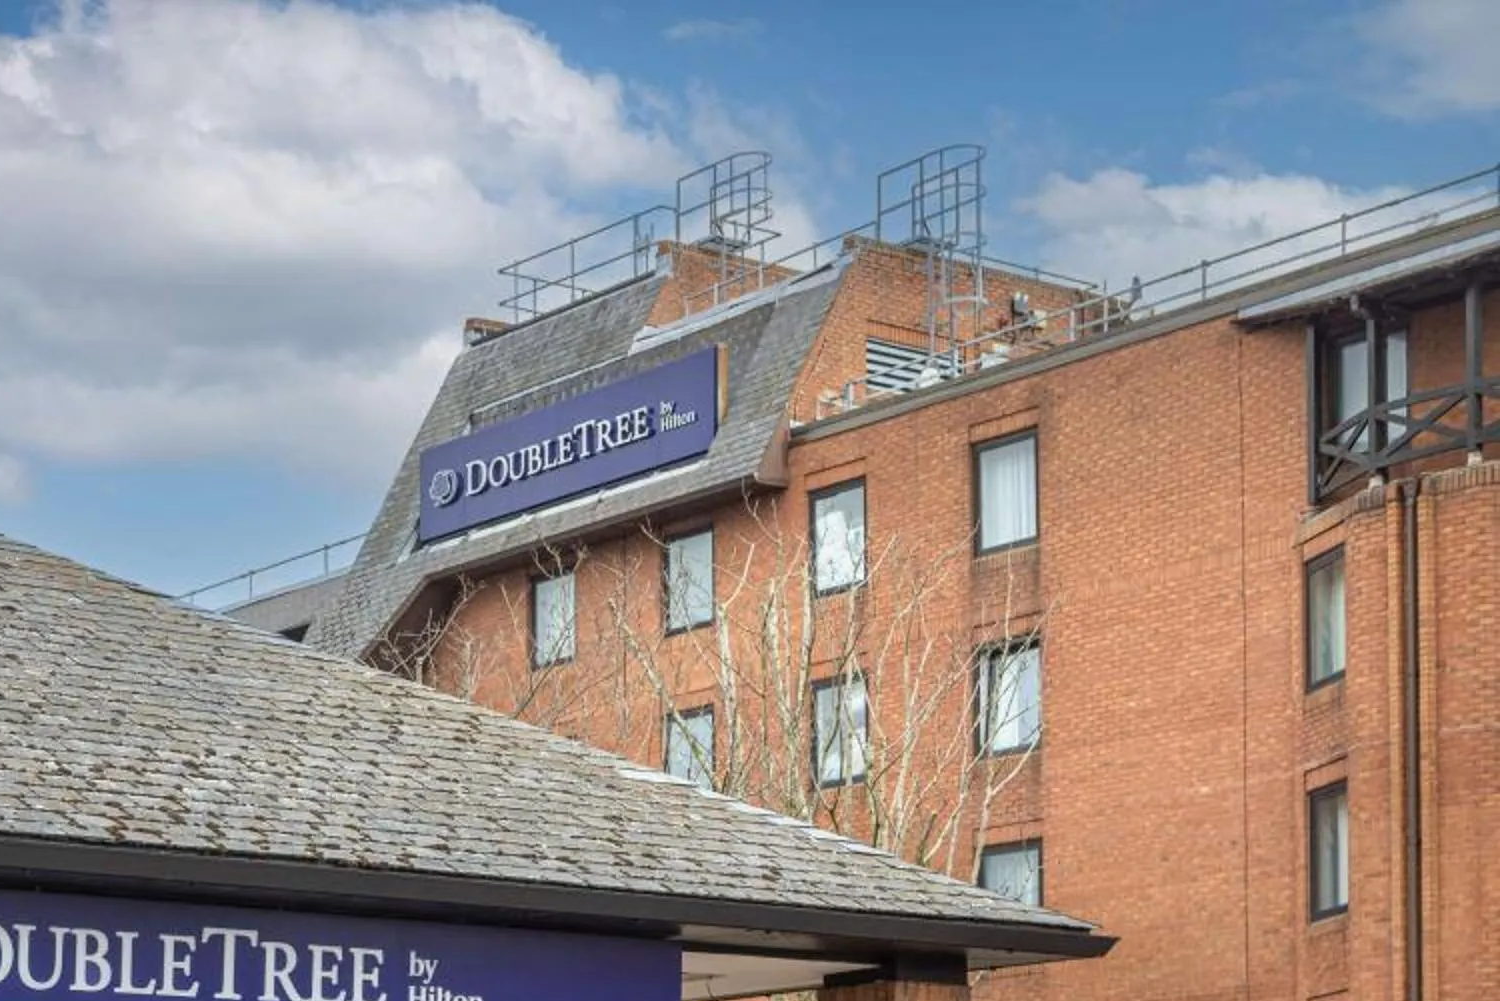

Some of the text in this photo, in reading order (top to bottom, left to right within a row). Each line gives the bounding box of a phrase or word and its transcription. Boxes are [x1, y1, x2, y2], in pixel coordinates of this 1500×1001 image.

[660, 411, 695, 432] Hilton
[465, 400, 675, 497] DOUBLETREE by
[408, 951, 440, 983] by
